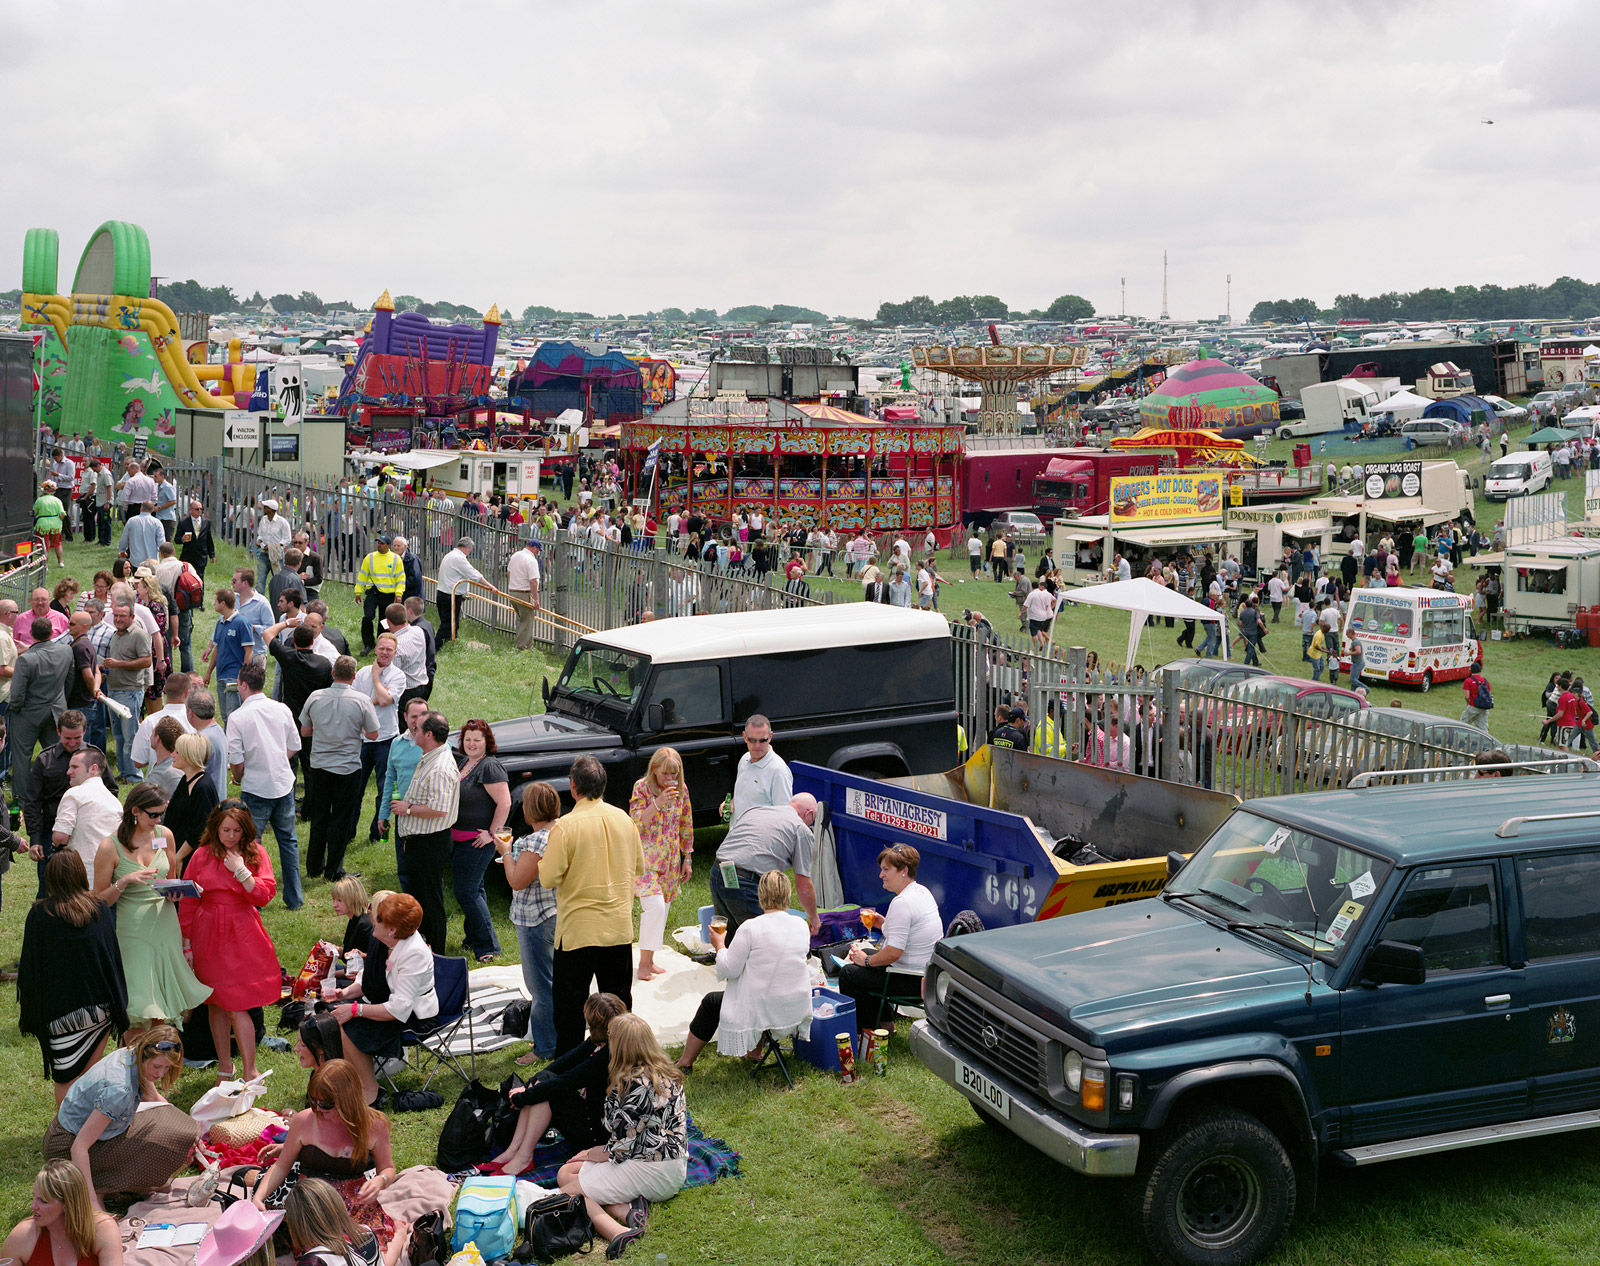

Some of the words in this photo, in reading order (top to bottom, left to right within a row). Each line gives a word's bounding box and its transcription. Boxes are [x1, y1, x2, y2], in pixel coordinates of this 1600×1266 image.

[1146, 433, 1211, 447] TWISTER
[1129, 465, 1155, 476] POWER
[1365, 464, 1390, 474] ORGANIC
[1390, 463, 1402, 473] HOG
[1403, 462, 1421, 473] ROAST
[1113, 480, 1151, 501] BURGERS
[1156, 479, 1172, 493] HOT
[1172, 478, 1193, 493] DOGS
[1198, 480, 1219, 497] CHIPS
[1136, 498, 1151, 509] CHEESE
[1151, 497, 1170, 506] BURGERS
[1173, 496, 1189, 505] CHEESE
[1189, 496, 1199, 506] DOGS
[1142, 509, 1154, 517] HOT
[1159, 508, 1173, 516] COLD
[1173, 507, 1192, 516] DRINKS
[1230, 511, 1274, 524] DONUTS
[1282, 511, 1303, 523] DONUTS
[1308, 509, 1329, 520] COOKIES
[1357, 594, 1385, 605] MISTER
[1385, 598, 1413, 608] FROSTY
[1418, 648, 1433, 656] FRESHLY
[1433, 647, 1441, 655] MADE
[864, 793, 942, 827] BRITANIACREST
[866, 809, 881, 820] Tel:
[881, 814, 905, 828] 01293
[907, 821, 938, 836] 820021
[962, 1065, 983, 1093] B20
